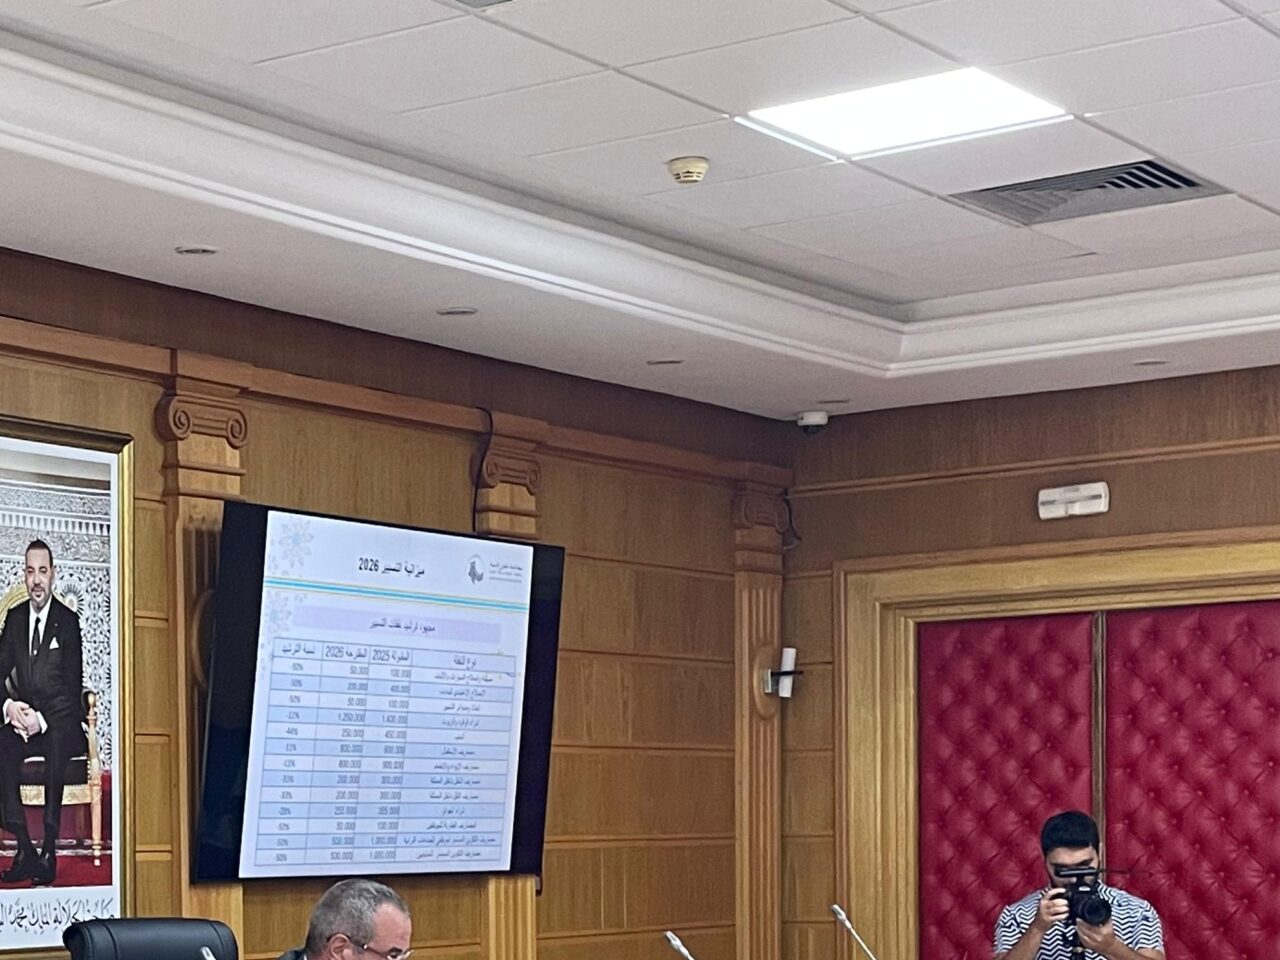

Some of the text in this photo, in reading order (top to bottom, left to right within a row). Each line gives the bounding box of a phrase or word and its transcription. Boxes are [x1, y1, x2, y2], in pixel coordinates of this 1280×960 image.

[358, 558, 379, 572] 2026
[325, 646, 344, 658] 2026
[372, 649, 390, 661] 2025
